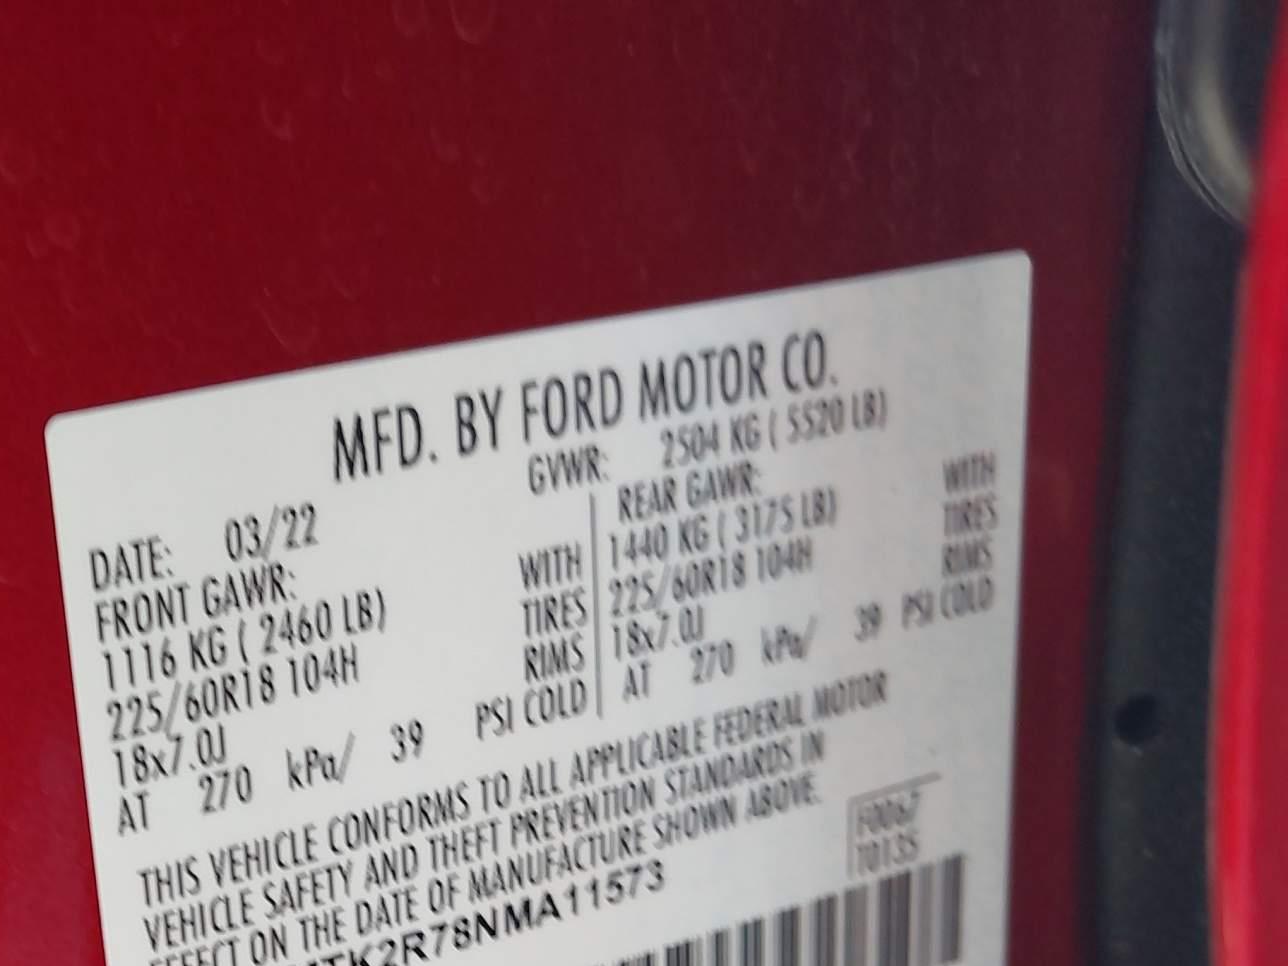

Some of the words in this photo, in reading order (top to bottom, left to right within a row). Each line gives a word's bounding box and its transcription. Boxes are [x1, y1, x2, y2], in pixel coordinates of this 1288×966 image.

[333, 405, 438, 483] MFD.
[454, 385, 504, 457] BY
[520, 367, 623, 442] FORD
[637, 340, 768, 422] MOTOR
[782, 330, 838, 394] CO.
[527, 446, 611, 495] GVWR:
[660, 422, 719, 468] 2504
[730, 413, 760, 452] KG
[787, 397, 844, 444] 5520
[852, 388, 888, 431] LB)
[88, 535, 174, 591] DATE:
[224, 502, 319, 562] 03/22
[609, 522, 668, 568] 1440
[679, 513, 711, 553] KG
[735, 495, 794, 542] 3175
[801, 487, 838, 528] LB)
[943, 451, 996, 494] WITH
[610, 553, 746, 617] 225/60R18
[756, 536, 812, 582] 104H
[944, 491, 998, 537] TIRES
[617, 476, 677, 522] REAR
[686, 460, 762, 508] GAWR:
[94, 582, 191, 643] FRONT
[202, 561, 298, 619] GAWR:
[103, 640, 177, 692] 1116
[188, 624, 227, 672] KG
[259, 600, 332, 657] 2460
[342, 587, 387, 633] LB)
[519, 543, 582, 590] WITH
[107, 666, 276, 743] 225/60R18
[288, 643, 359, 698] 104H
[520, 587, 588, 638] TIRES
[613, 605, 705, 661] 18x7.0J
[941, 533, 993, 579] RIMS
[623, 664, 651, 702] AT
[690, 640, 735, 685] 270
[761, 615, 818, 665] kPa/
[854, 600, 882, 642] 39
[902, 588, 934, 631] PSI
[940, 574, 995, 620] COLD
[114, 723, 228, 789] 18x7.0J
[524, 632, 586, 684] RIMS
[118, 793, 151, 837] AT
[200, 765, 253, 816] 270
[286, 730, 356, 791] kPa/
[390, 720, 424, 764] 39
[474, 698, 513, 741] PSI
[524, 679, 587, 728] COLD
[138, 856, 201, 906] THIS
[208, 823, 318, 888] VEHICLE
[327, 781, 470, 854] CONFORMS
[477, 770, 511, 812] TO
[519, 757, 559, 802] ALL
[570, 717, 707, 788] APPLICABLE
[713, 692, 804, 748] FEDERAL
[813, 669, 887, 721] MOTOR
[143, 888, 254, 953] VEHICLE
[262, 860, 354, 919] SAFETY
[364, 844, 418, 891] AND
[425, 817, 502, 872] THEFT
[511, 776, 655, 846] PREVENTION
[663, 737, 793, 802] STANDARDS
[801, 730, 825, 765] IN
[249, 924, 288, 966] ON
[299, 906, 346, 953] THE
[355, 888, 420, 935] DATE
[428, 873, 460, 914] OF
[468, 825, 647, 899] MANUFACTURE
[652, 792, 738, 850] SHOWN
[745, 769, 820, 822] ABOVE.
